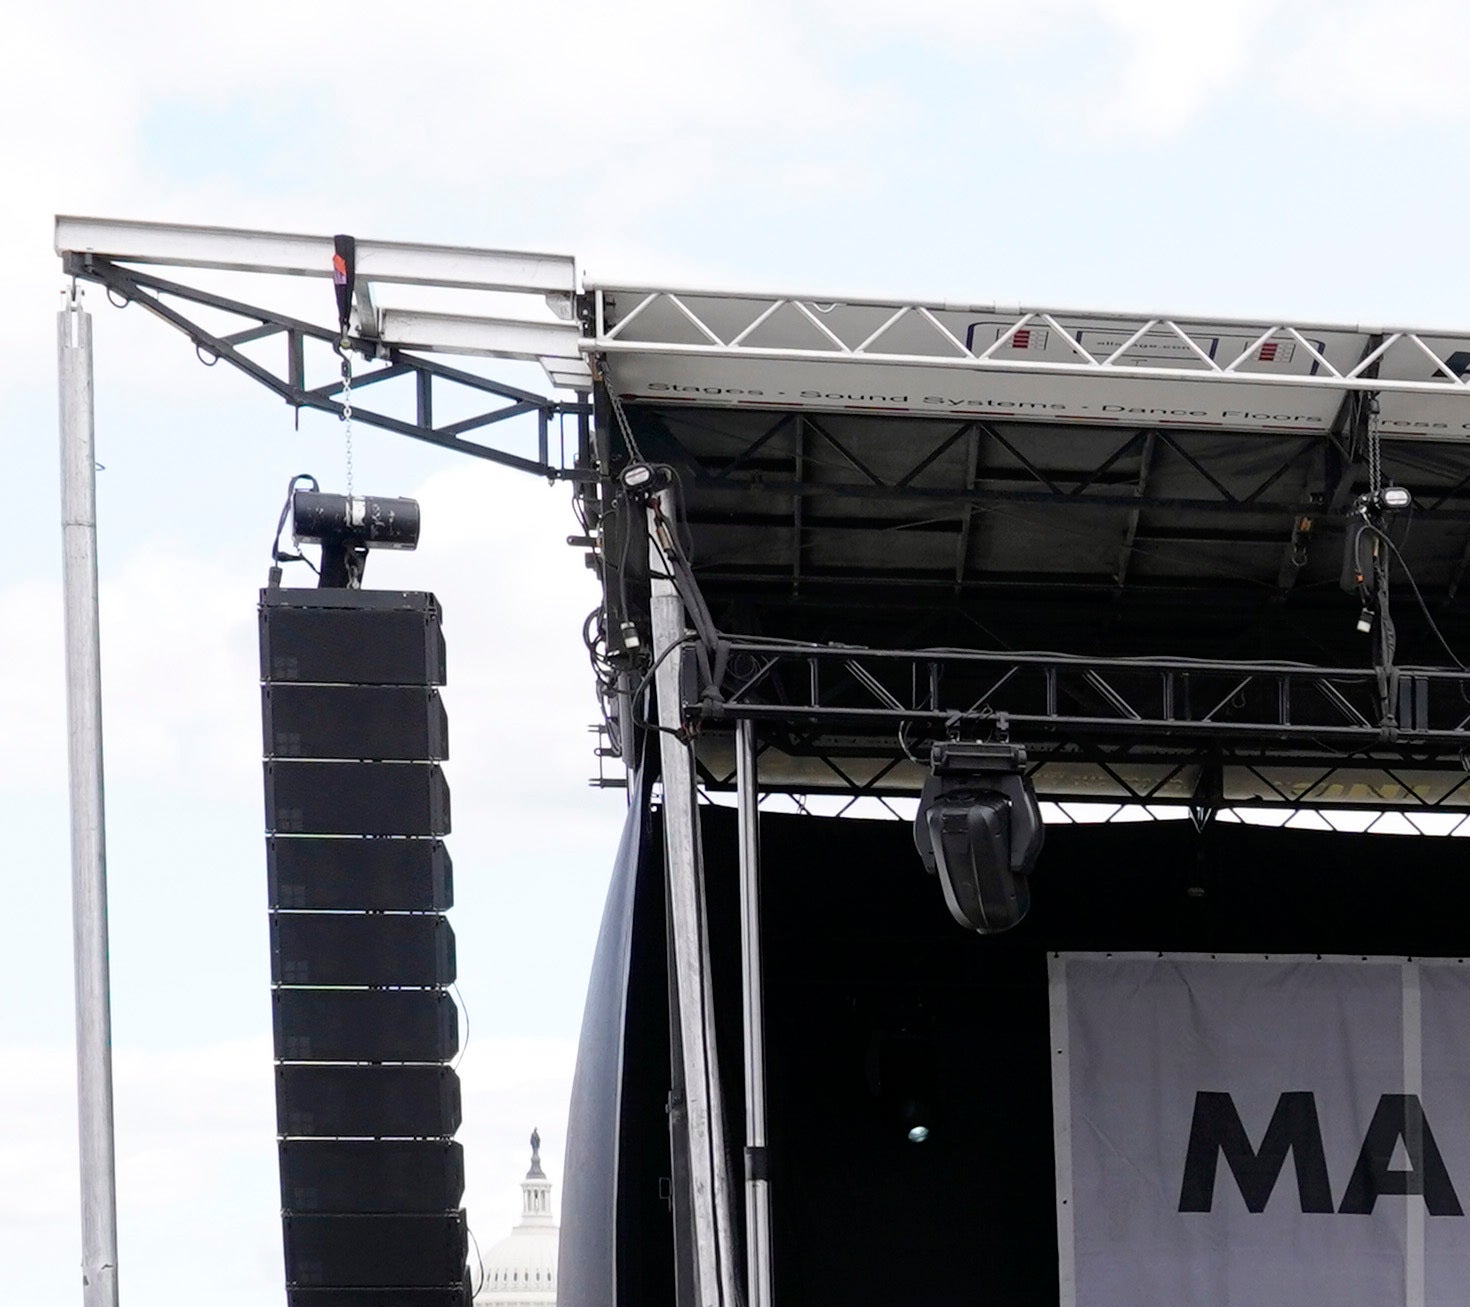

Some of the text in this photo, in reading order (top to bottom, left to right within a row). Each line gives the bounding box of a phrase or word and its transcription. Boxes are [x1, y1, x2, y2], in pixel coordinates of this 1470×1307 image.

[648, 382, 764, 396] Stages
[801, 390, 908, 402] Sound
[923, 395, 1066, 411] Systems
[1102, 404, 1208, 416] Dance
[1222, 410, 1322, 422] Floors
[1380, 419, 1447, 429] ress
